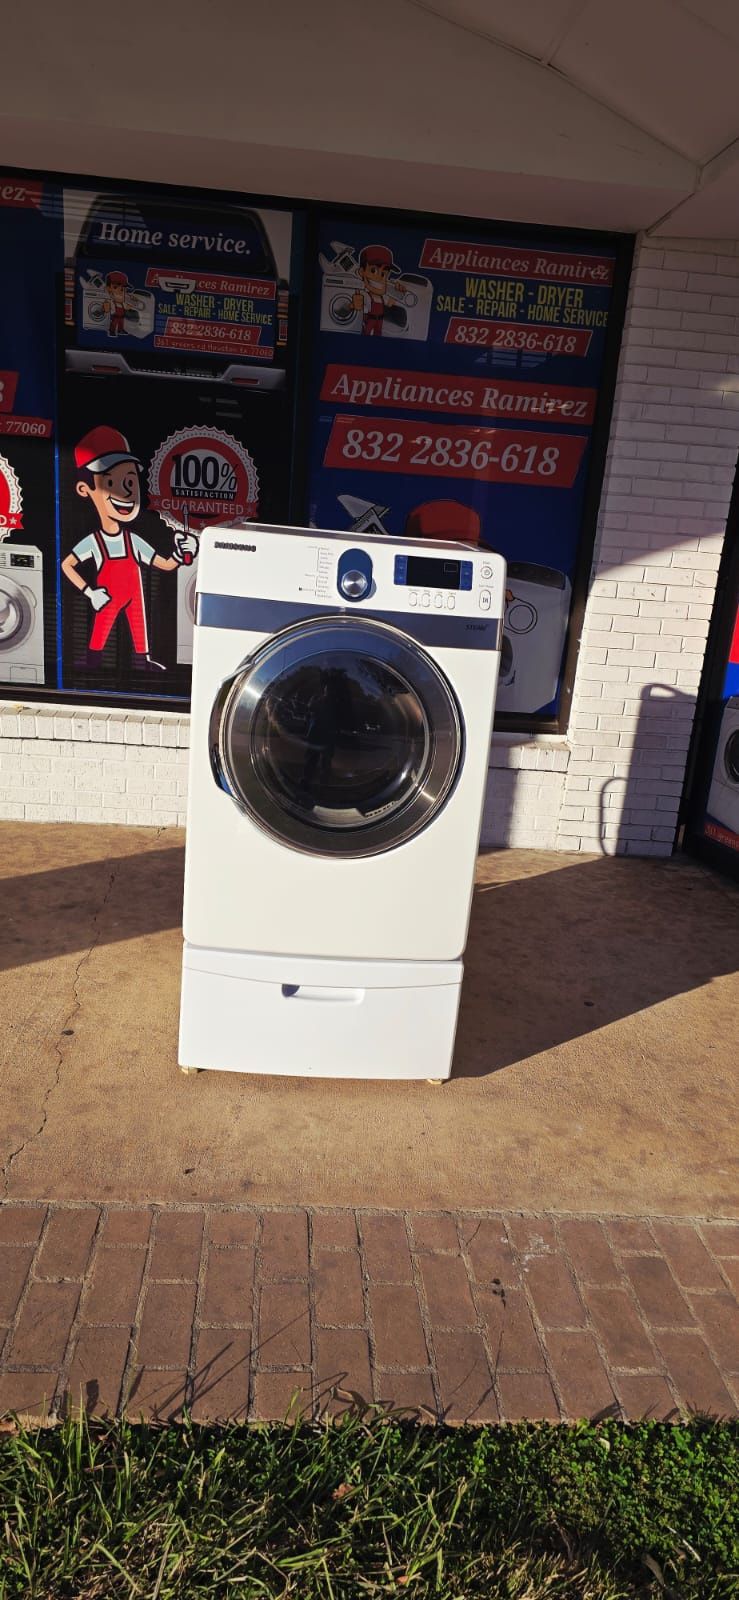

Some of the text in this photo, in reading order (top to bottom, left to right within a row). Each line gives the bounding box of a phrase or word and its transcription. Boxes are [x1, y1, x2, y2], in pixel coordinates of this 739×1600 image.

[0, 186, 26, 202] ez
[98, 222, 251, 254] Home service.
[429, 247, 609, 281] Appliances Ramirez
[219, 280, 271, 296] Ramirez
[465, 277, 525, 303] WASHER
[538, 285, 584, 309] DRYER
[158, 303, 177, 315] SALE
[184, 306, 212, 319] REPAIR
[218, 310, 240, 322] HOME
[241, 312, 273, 326] SERVICE
[176, 293, 215, 309] WASHER
[224, 297, 254, 313] DRYER
[436, 295, 465, 314] SALE
[476, 299, 517, 319] REPAIR
[528, 304, 560, 323] HOME
[563, 308, 609, 328] SERVICE
[171, 322, 252, 341] 832 2836-618
[454, 325, 577, 353] 832 2836-618
[331, 374, 589, 418] Appliances Ramirez
[6, 421, 46, 435] 77060
[342, 429, 560, 476] 832 2836-618
[171, 454, 239, 491] 100%
[161, 498, 244, 515] GUARANTEED
[175, 488, 234, 500] SATISFACTION
